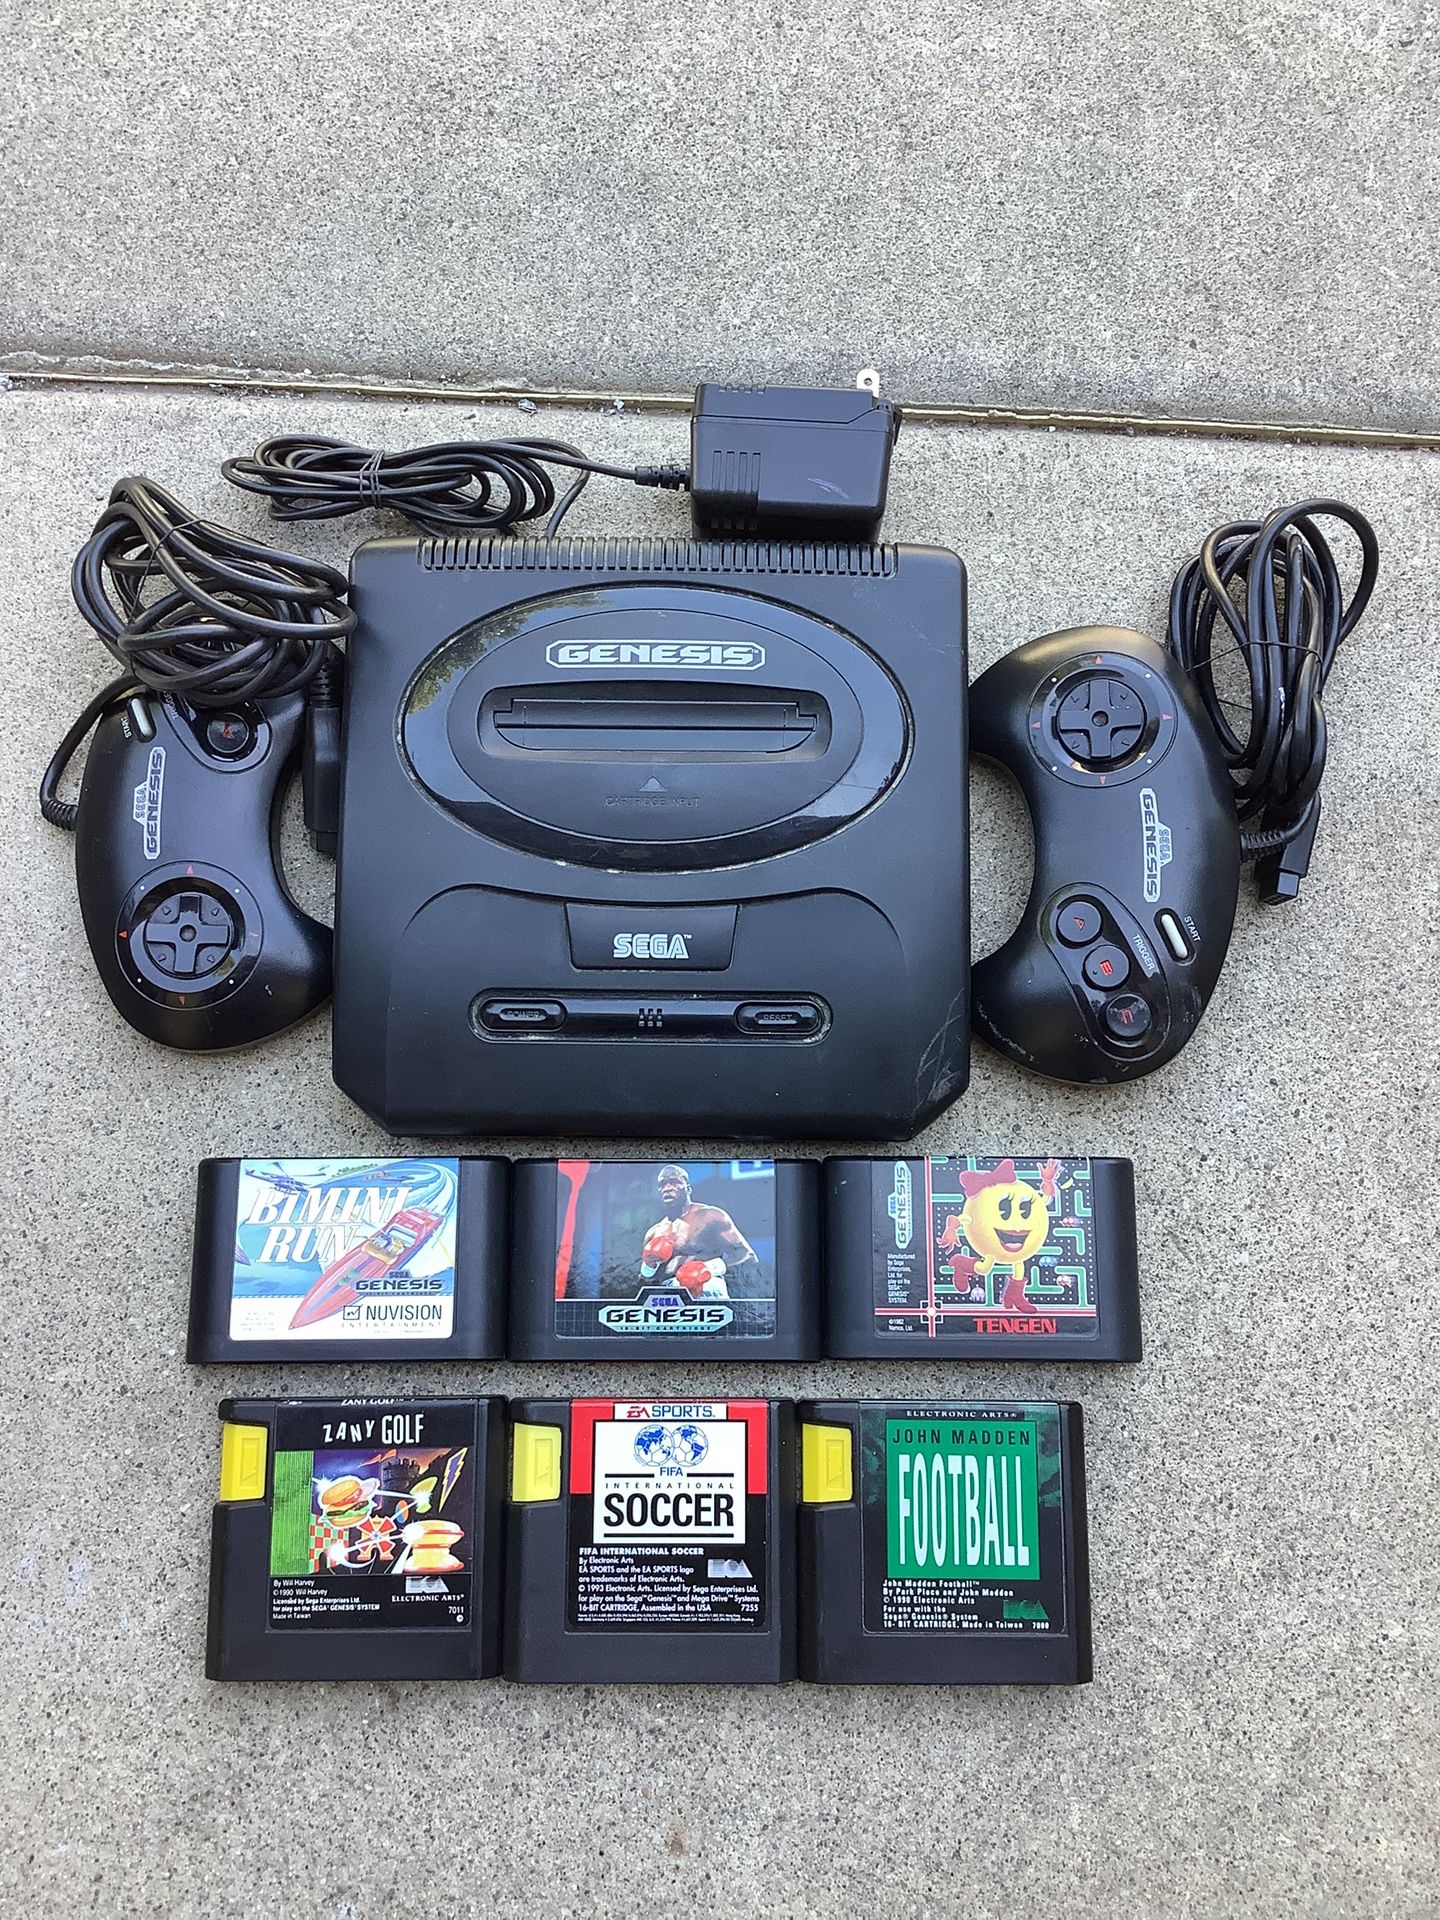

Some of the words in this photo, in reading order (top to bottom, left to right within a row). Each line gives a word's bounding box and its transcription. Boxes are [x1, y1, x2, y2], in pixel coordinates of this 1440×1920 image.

[146, 749, 163, 853] GENESIS
[1142, 793, 1158, 897] GENESIS
[1159, 828, 1171, 861] SEGA
[1073, 916, 1086, 932] A
[1184, 915, 1201, 942] START
[1132, 933, 1156, 970] TRIGGER
[1100, 959, 1114, 976] B
[245, 1186, 413, 1225] BIMINI
[896, 1166, 907, 1244] GENESIS
[255, 1225, 360, 1264] RUN
[355, 1280, 443, 1291] GENESIS
[651, 1297, 679, 1307] SEGA
[366, 1304, 442, 1321] NUVISION
[606, 1308, 725, 1323] GENESIS
[973, 1317, 1057, 1333] TENGEN
[627, 1405, 651, 1418] EA
[906, 1410, 977, 1418] ELECTRONIC
[322, 1419, 375, 1443] ZANY
[381, 1413, 425, 1444] GOLF
[893, 1428, 941, 1444] JOHN
[951, 1429, 1030, 1445] MADDEN
[660, 1467, 684, 1477] FIFA
[603, 1492, 734, 1527] SOCCER
[898, 1452, 1030, 1567] FOOTBALL
[579, 1547, 598, 1555] FIFA
[600, 1547, 670, 1555] INTERNATIONAL
[671, 1547, 705, 1555] SOCCER
[578, 1557, 588, 1566] By
[588, 1556, 619, 1564] Electronic
[620, 1556, 634, 1564] Arts
[578, 1565, 588, 1574] EA
[589, 1565, 615, 1574] SPORTS
[616, 1565, 629, 1574] and
[630, 1565, 641, 1574] the
[642, 1565, 652, 1574] EA
[652, 1565, 678, 1574] SPORTS
[679, 1565, 695, 1575] logo
[294, 1579, 315, 1587] Harvey
[591, 1574, 628, 1583] trademarks
[629, 1574, 637, 1583] of
[637, 1574, 668, 1583] Electronic
[882, 1579, 902, 1587] John
[905, 1579, 937, 1588] Madden
[295, 1588, 306, 1596] Will
[307, 1588, 328, 1596] Harvey
[587, 1584, 604, 1592] 1993
[605, 1584, 636, 1592] Electronic
[653, 1584, 681, 1592] Licensed
[682, 1584, 691, 1594] by
[692, 1585, 709, 1594] Sega
[710, 1585, 745, 1594] Enterprises
[746, 1584, 758, 1593] Ltd.
[883, 1588, 893, 1597] By
[896, 1588, 914, 1596] Park
[917, 1588, 940, 1596] Place
[942, 1588, 957, 1596] and
[959, 1588, 979, 1596] John
[982, 1588, 1014, 1596] Madden
[578, 1593, 588, 1602] for
[589, 1593, 604, 1603] play
[614, 1593, 625, 1602] the
[677, 1593, 689, 1602] and
[690, 1594, 710, 1604] Mega
[734, 1594, 760, 1604] Systems
[893, 1596, 911, 1604] 1990
[913, 1596, 955, 1604] Electronic
[958, 1596, 975, 1604] Arts
[281, 1605, 293, 1613] play
[448, 1606, 464, 1614] 7011
[579, 1603, 599, 1611] 16-BIT
[640, 1603, 676, 1611] Assembled
[677, 1603, 684, 1611] in
[685, 1603, 696, 1611] the
[697, 1603, 712, 1611] USA
[740, 1603, 759, 1612] 7255
[883, 1605, 896, 1613] For
[914, 1605, 931, 1613] with
[933, 1605, 946, 1613] the
[951, 1613, 979, 1622] System
[995, 1621, 1023, 1629] Taiwan
